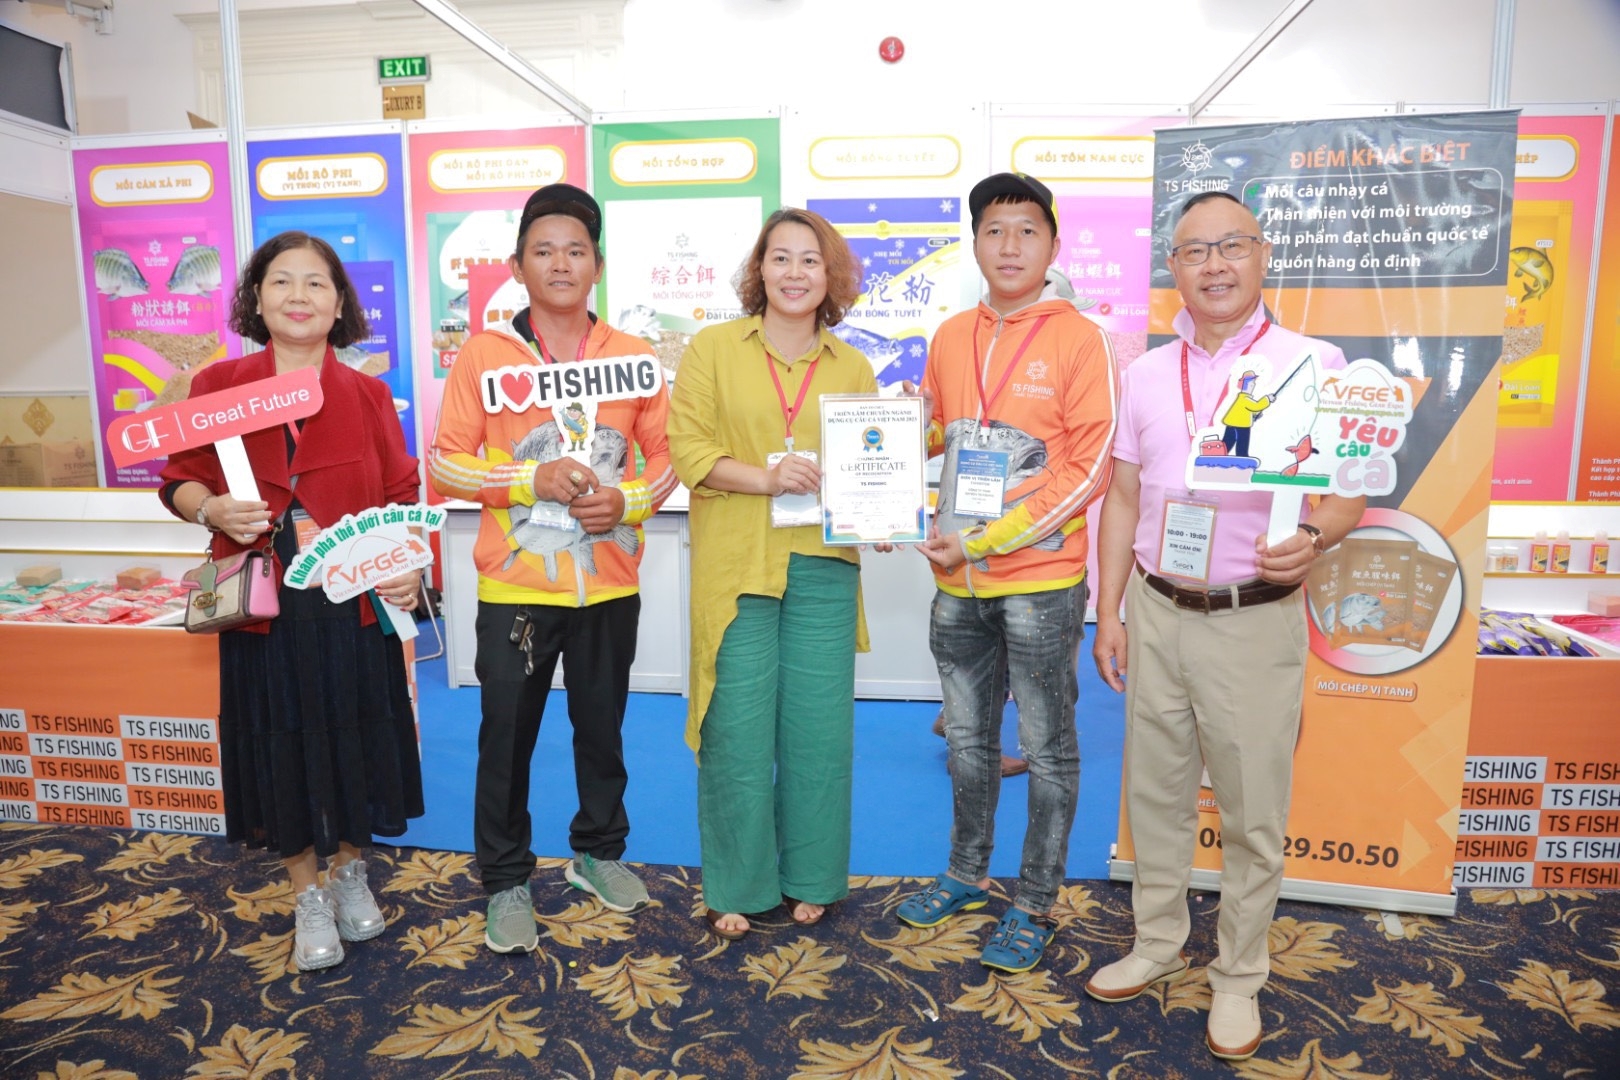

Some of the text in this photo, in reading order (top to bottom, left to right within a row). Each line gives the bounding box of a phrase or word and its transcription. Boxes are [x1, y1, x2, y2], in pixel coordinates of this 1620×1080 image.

[383, 58, 422, 76] EXIT
[385, 95, 422, 111] LUXURY B
[485, 159, 502, 168] PHI
[1061, 152, 1086, 163] TÔM
[1090, 154, 1116, 162] NAM
[1289, 139, 1471, 169] ĐIỂM KHÁC BIỆT
[176, 178, 192, 187] PHI
[313, 167, 352, 179] RÔ PHI
[508, 171, 525, 179] PHI
[1164, 179, 1229, 192] TS FISHING
[1298, 184, 1324, 198] câu
[1328, 181, 1368, 200] nhạy
[1370, 182, 1389, 196] cá
[1265, 203, 1472, 223] Thân thiện với môi trường
[1294, 228, 1339, 248] phẩm
[1343, 230, 1369, 246] đạt
[1372, 227, 1422, 243] chuẩn
[1426, 228, 1468, 246] quốc
[1471, 224, 1491, 240] tế
[1317, 254, 1356, 271] hàng
[1360, 251, 1382, 268] ổn
[1384, 253, 1421, 271] định
[651, 264, 716, 286] 綜合餌
[865, 271, 936, 306] 花粉
[487, 360, 655, 406] I FISHING
[1012, 383, 1055, 396] TS FISHING
[1334, 385, 1389, 402] VFGE
[191, 403, 246, 430] Great
[249, 388, 311, 416] Future
[1339, 415, 1399, 448] Yêu
[1336, 440, 1371, 458] câu
[840, 462, 907, 472] CERTIFICATE
[1167, 528, 1184, 537] 10:00
[1189, 532, 1208, 541] 19:00
[289, 554, 318, 585] Khám
[314, 534, 337, 559] phá
[356, 512, 380, 535] giới
[383, 508, 404, 524] câu
[408, 508, 422, 522] cá
[425, 510, 443, 527] tại
[340, 546, 407, 585] VFGE
[1341, 682, 1369, 693] CHÉP
[1371, 686, 1381, 696] VỊ
[1383, 686, 1414, 697] TANH
[32, 715, 51, 731] TS
[54, 716, 114, 734] FISHING
[126, 720, 210, 739] TS FISHING
[35, 738, 54, 753] TS
[58, 739, 117, 757] FISHING
[129, 744, 213, 763] TS FISHING
[38, 761, 57, 777] TS
[61, 762, 120, 780] FISHING
[132, 767, 215, 787] TS FISHING
[1554, 762, 1620, 780] TS FISH
[41, 784, 122, 803] TS FISHING
[134, 790, 218, 810] TS FISHING
[1551, 789, 1620, 806] TS FISH
[43, 806, 125, 826] TS FISHING
[137, 813, 220, 832] TS FISHING
[1548, 815, 1619, 833] TS FISH
[1546, 841, 1620, 858] TS FISHI
[1542, 866, 1619, 885] TS FISHI
